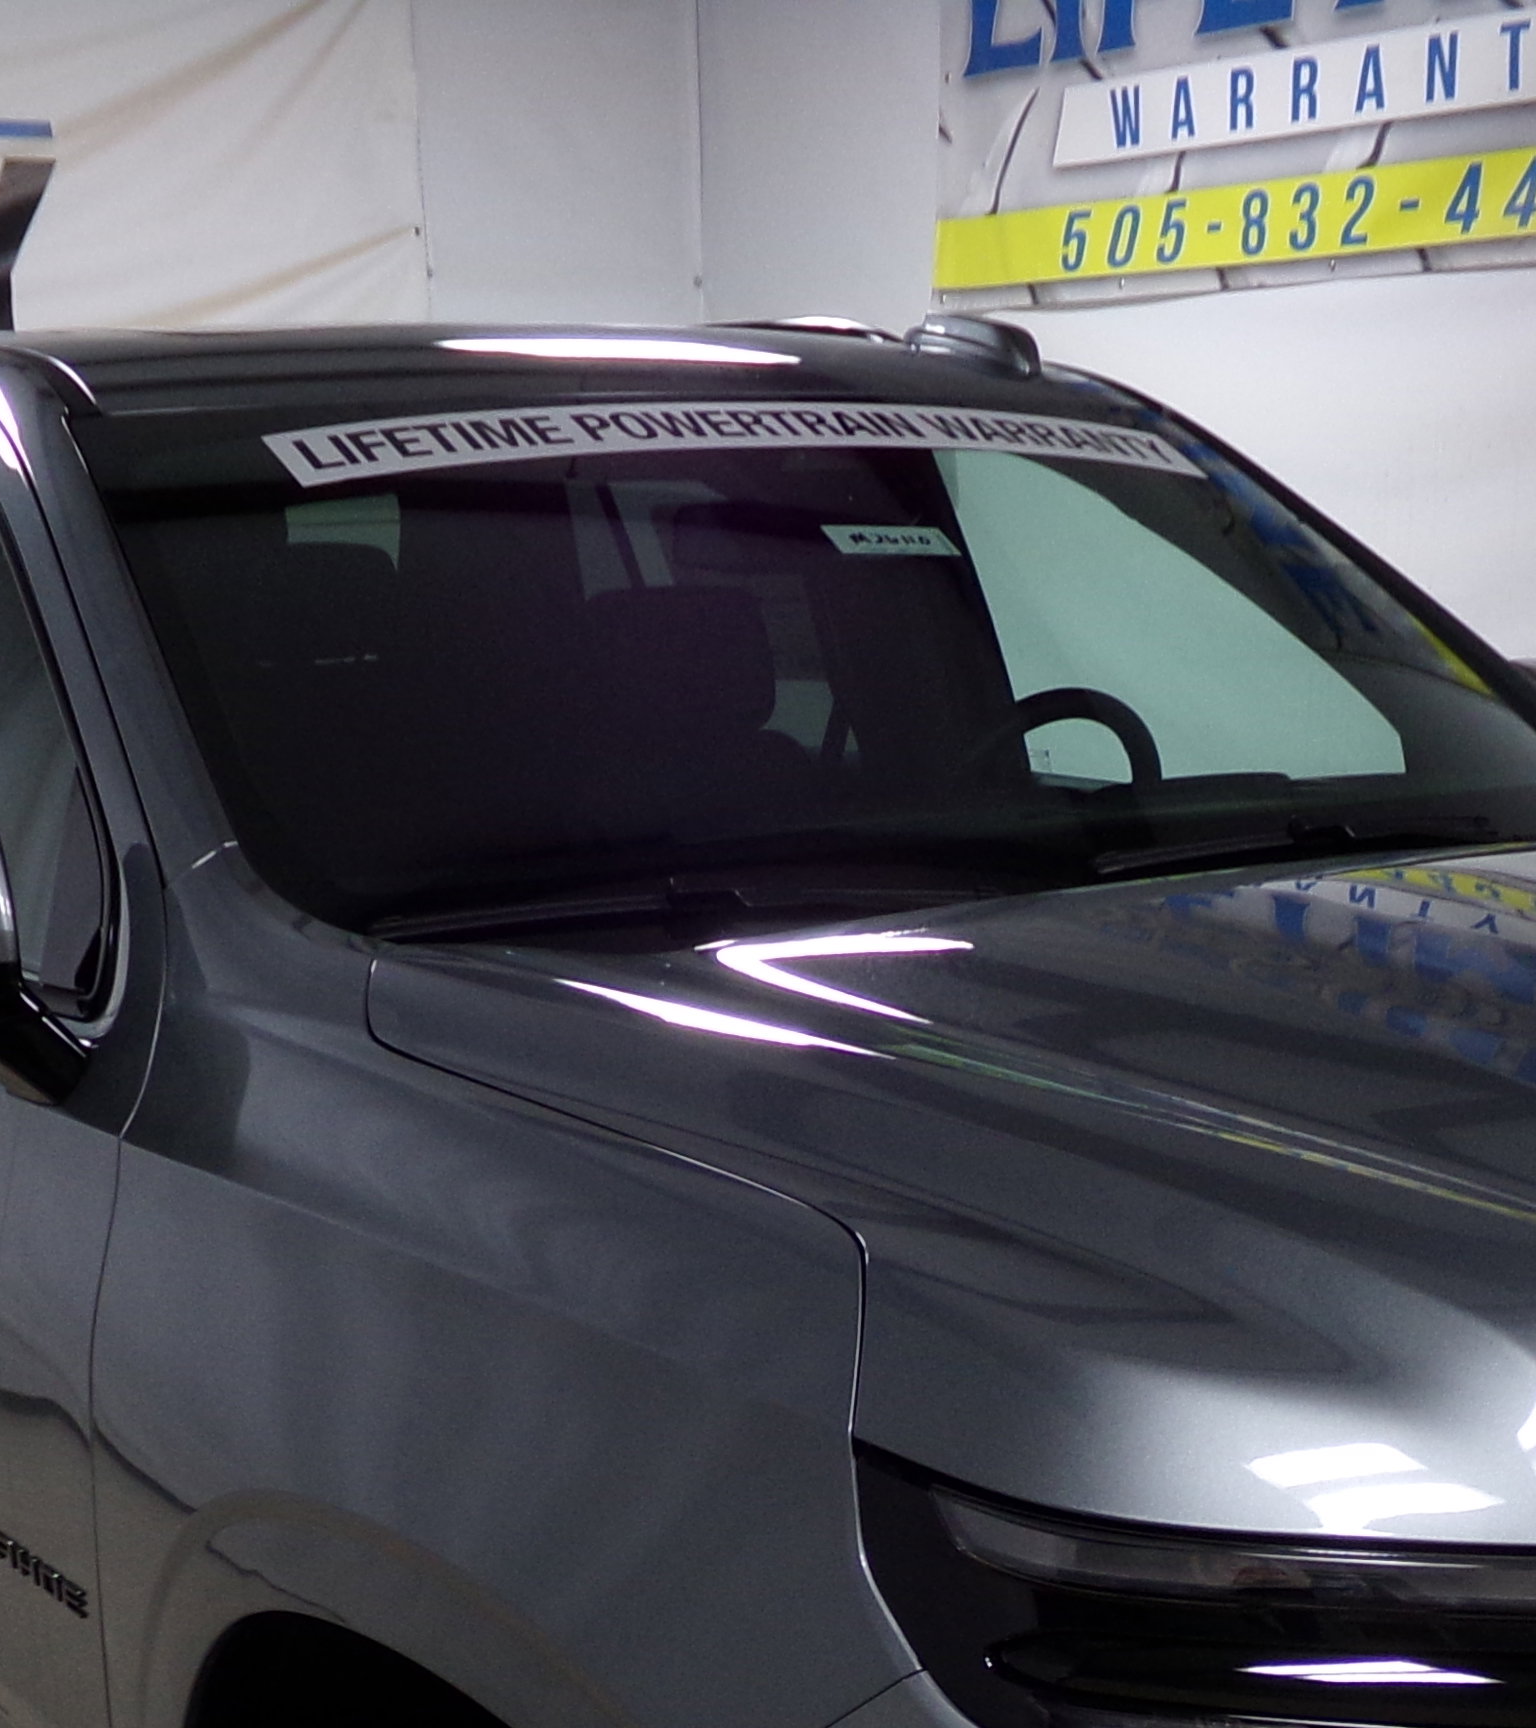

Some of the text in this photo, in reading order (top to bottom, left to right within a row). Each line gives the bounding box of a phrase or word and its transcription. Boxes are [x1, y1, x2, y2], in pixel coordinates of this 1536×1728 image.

[292, 409, 1172, 472] LIFETIME POWERTRAIN WARRANTY
